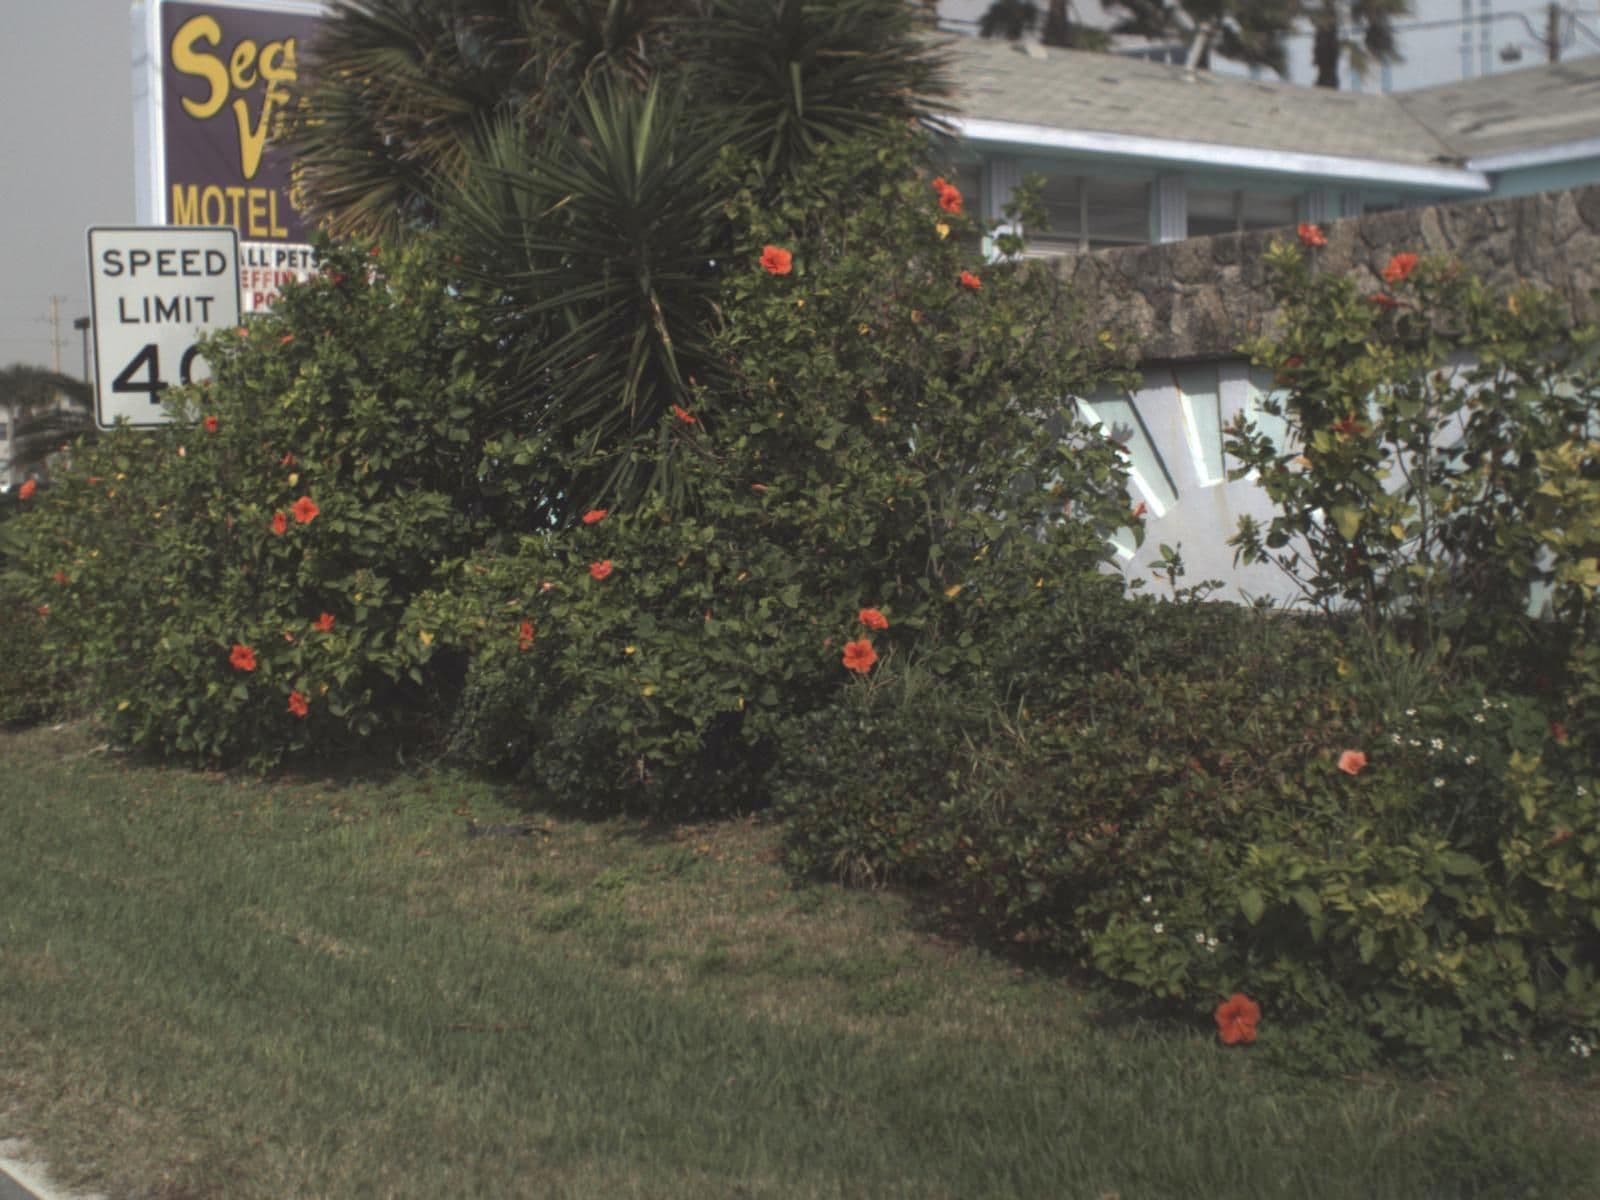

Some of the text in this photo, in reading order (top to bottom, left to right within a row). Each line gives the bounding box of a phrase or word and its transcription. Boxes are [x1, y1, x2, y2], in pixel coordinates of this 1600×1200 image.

[171, 14, 297, 119] Sea
[172, 184, 288, 238] MOTEL
[103, 249, 227, 277] SPEED
[118, 296, 215, 324] LIMIT
